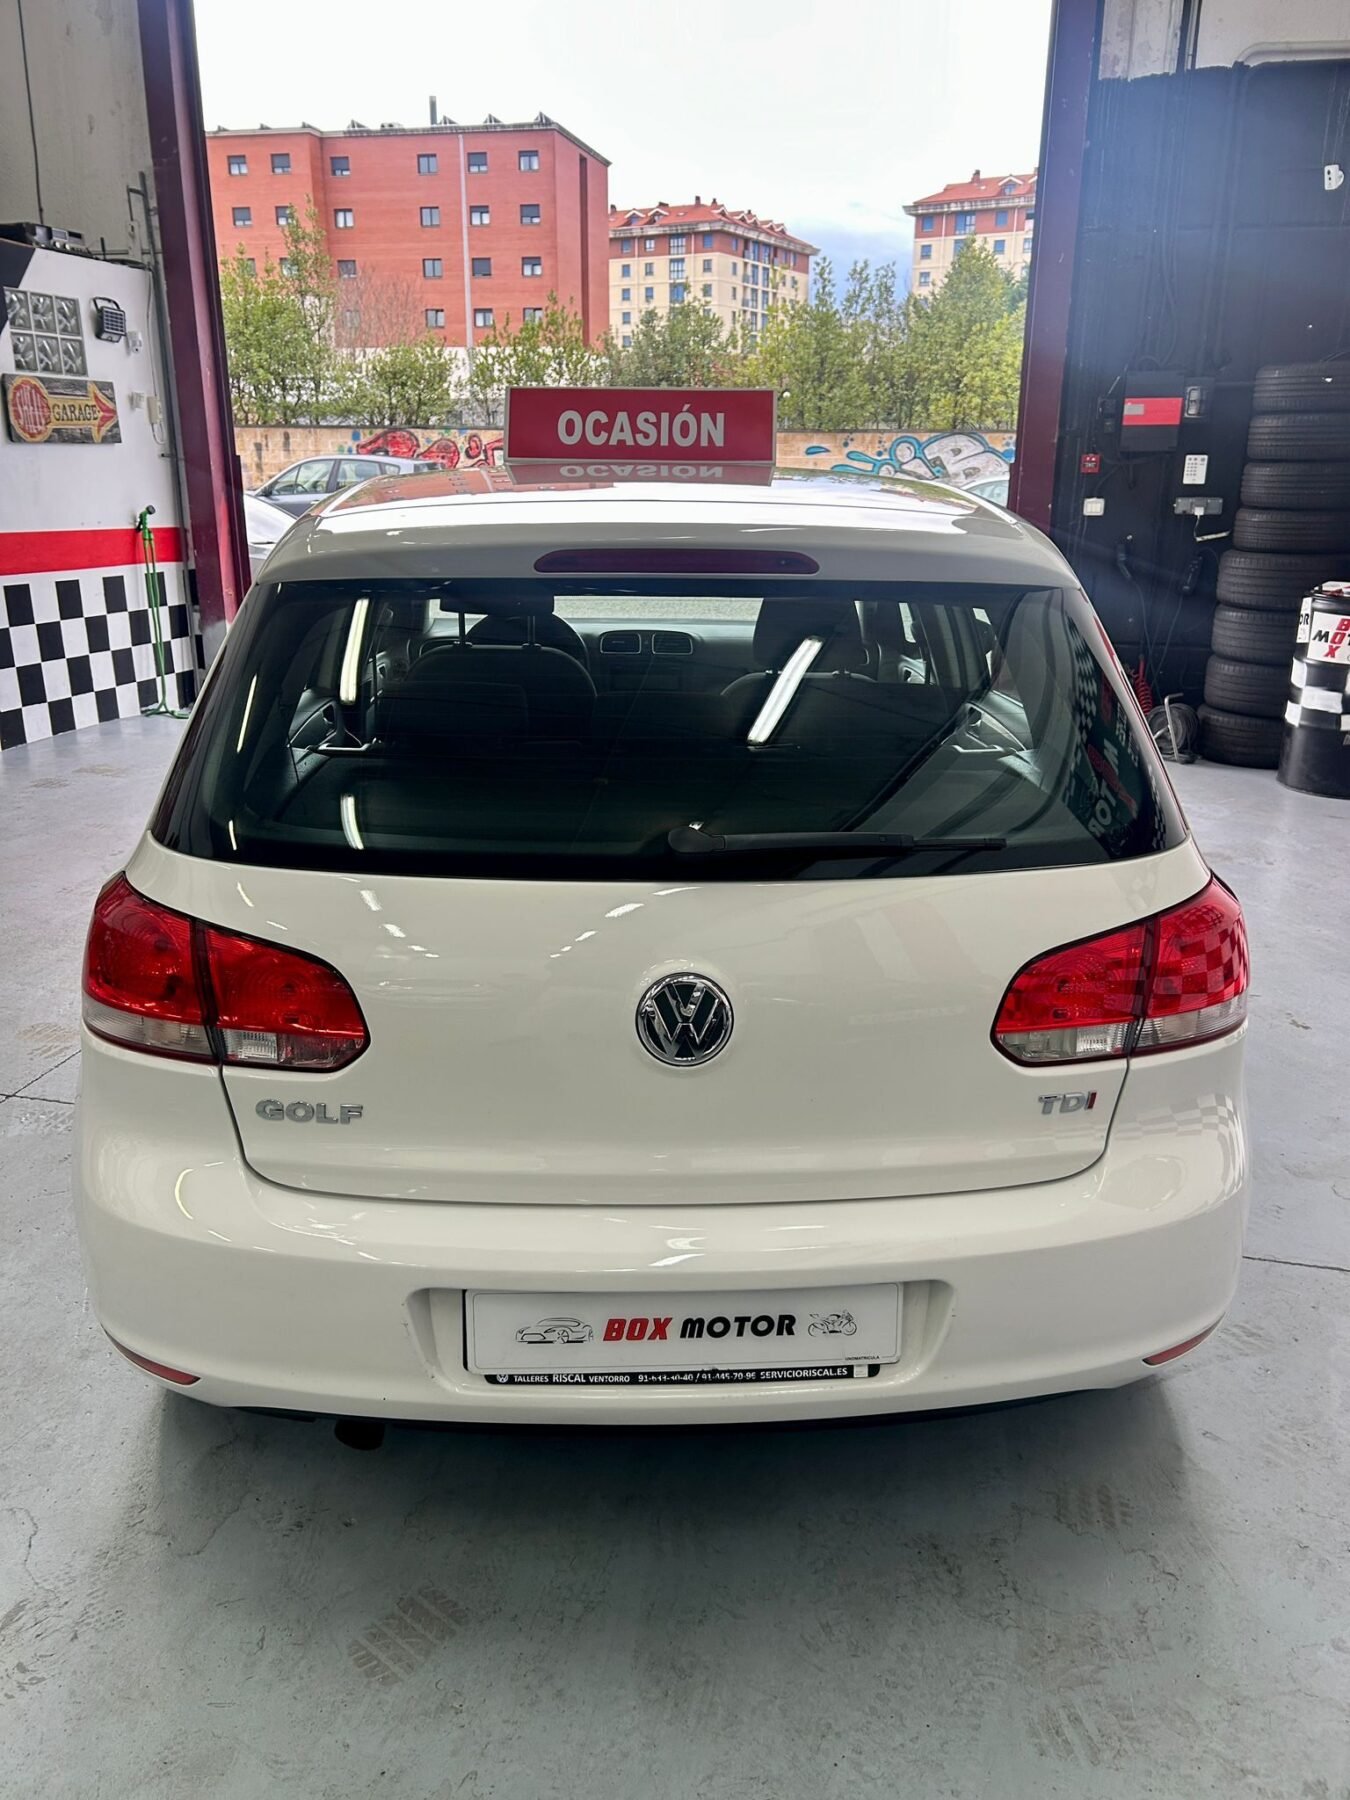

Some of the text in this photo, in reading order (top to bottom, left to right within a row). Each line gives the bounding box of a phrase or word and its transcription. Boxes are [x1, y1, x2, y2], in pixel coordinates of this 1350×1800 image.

[52, 404, 99, 421] GARAGE
[557, 404, 726, 447] OCASIÓN
[255, 1099, 363, 1125] GOLF
[1038, 1091, 1097, 1115] TDI
[603, 1314, 796, 1341] BOX MOTOR
[514, 1375, 549, 1383] TALLERES
[552, 1373, 586, 1383] RISCAL
[589, 1375, 630, 1383] VENTORRO
[760, 1367, 848, 1379] SERVICIORISCAL.ES
